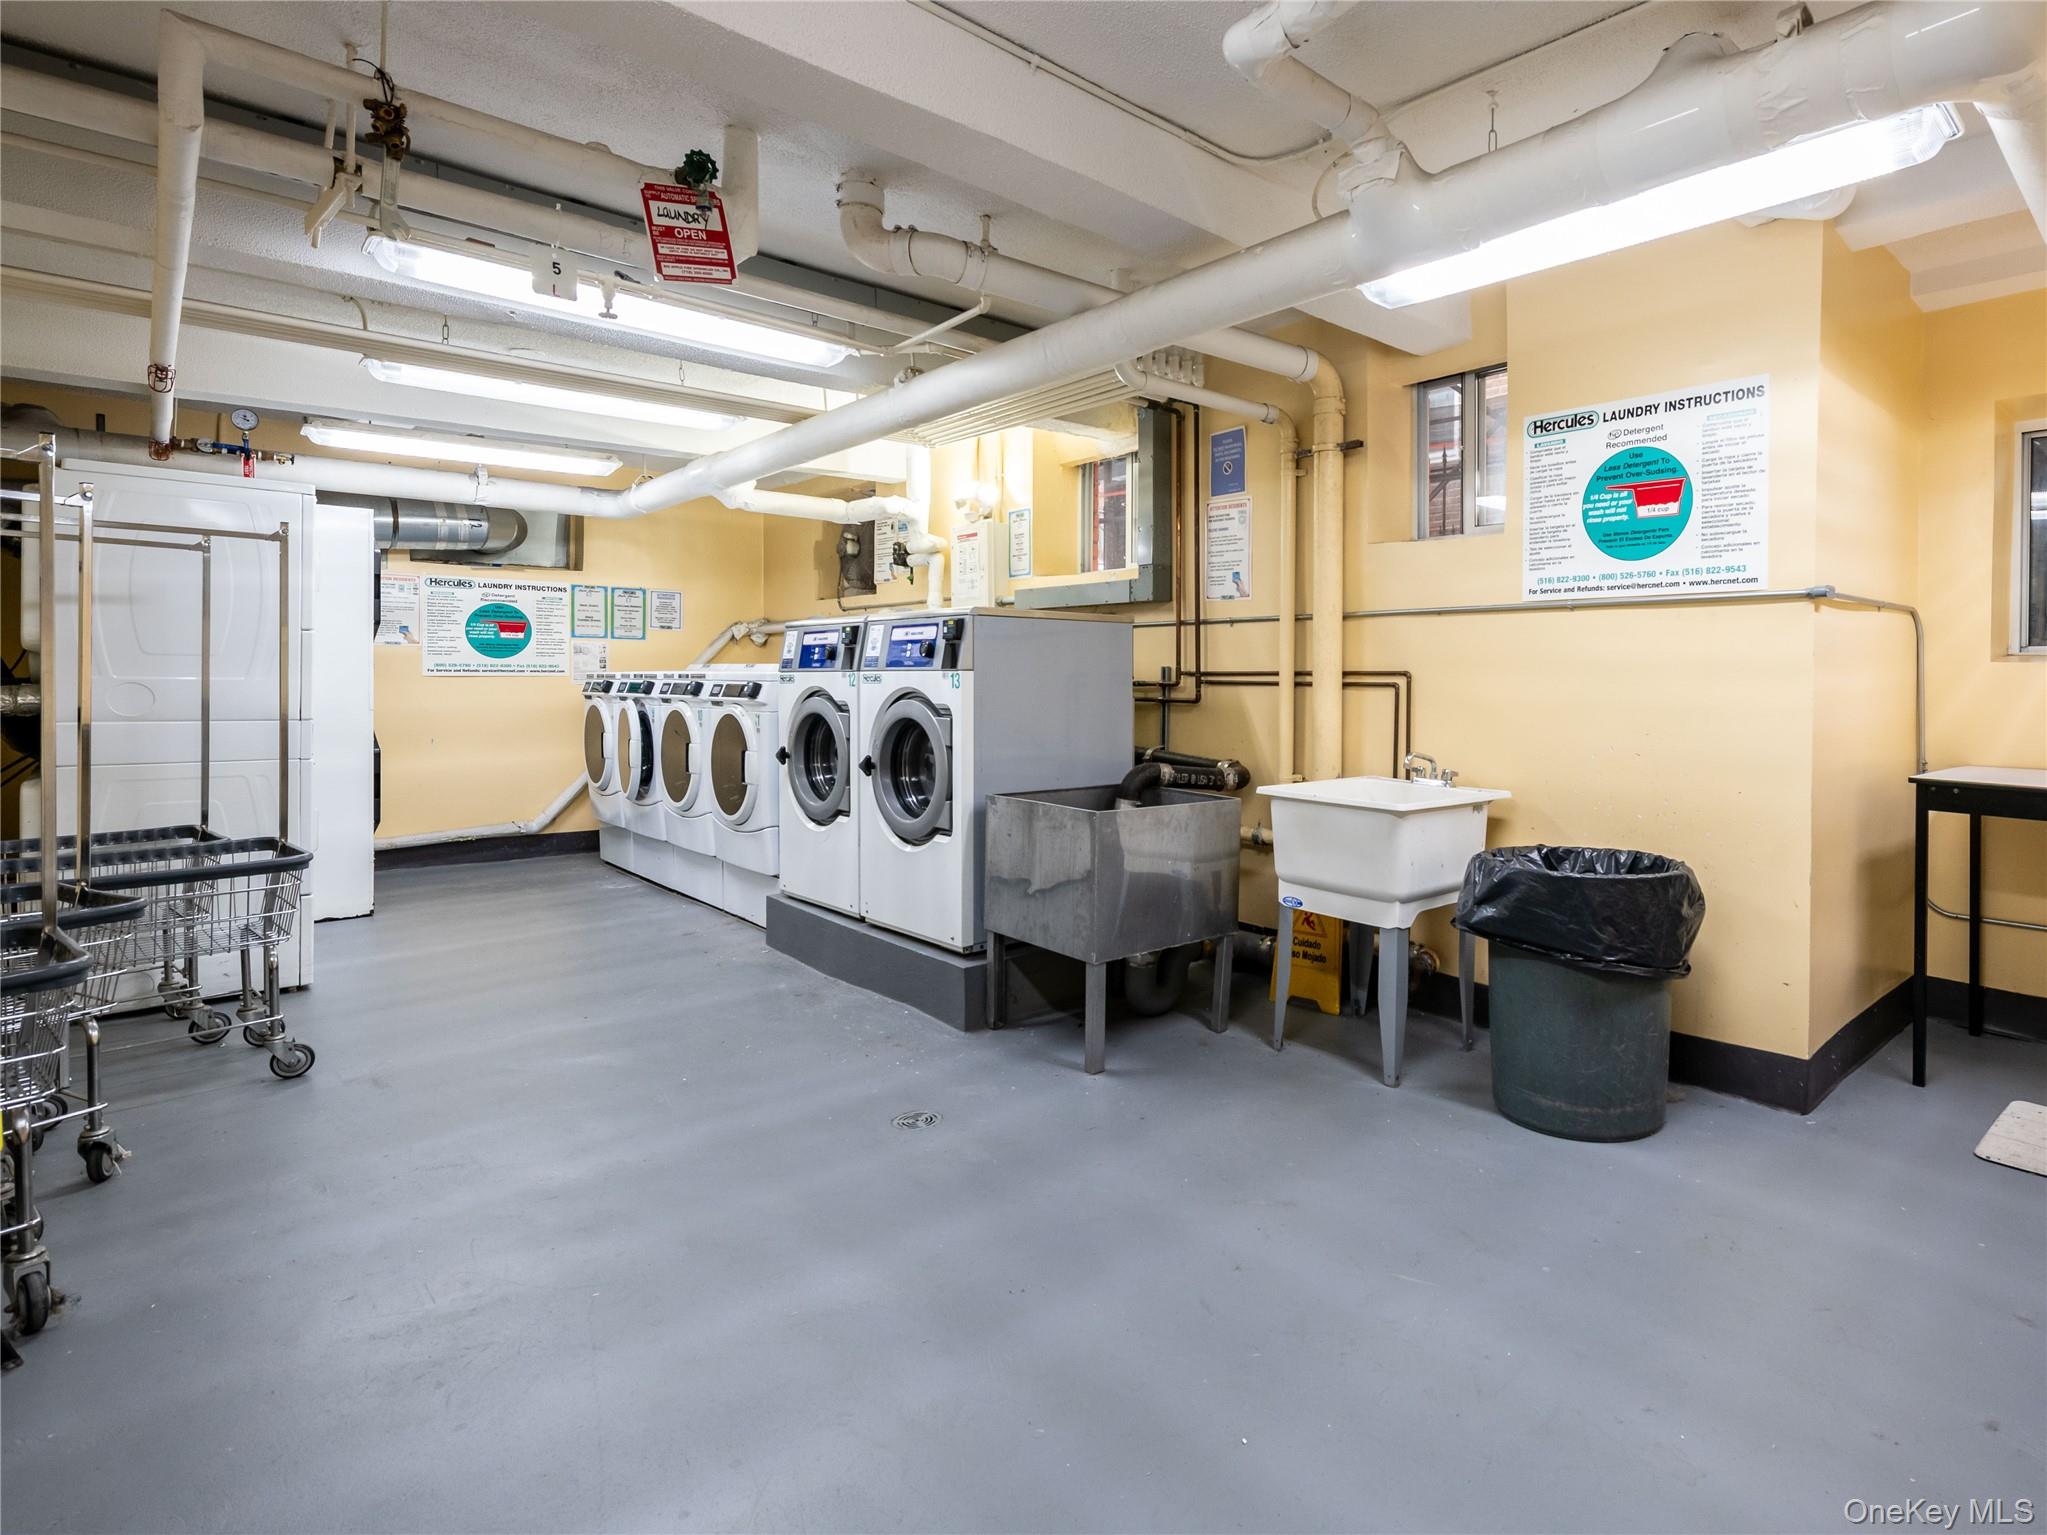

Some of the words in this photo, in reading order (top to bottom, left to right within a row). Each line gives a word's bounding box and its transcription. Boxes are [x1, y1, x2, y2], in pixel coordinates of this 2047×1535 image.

[674, 228, 707, 240] OPEN
[552, 261, 562, 276] 5
[1533, 413, 1594, 435] Hercules
[1603, 402, 1661, 423] LAUNDRY
[1664, 384, 1766, 413] INSTRUCTIONS
[1623, 424, 1664, 437] Detergent
[1606, 434, 1668, 449] Recommended
[1623, 459, 1659, 470] Detergent
[1596, 472, 1624, 482] Prevent
[1598, 572, 1618, 583] (800)
[1665, 569, 1680, 577] Fax
[1682, 567, 1704, 577] (516)
[1705, 564, 1747, 575] 822-9543
[429, 577, 473, 588] Hercules
[477, 582, 513, 590] LAUNDRY
[514, 583, 568, 593] INSTRUCTIONS
[1577, 584, 1605, 592] Refunds:
[1606, 581, 1681, 592] service@hercnet.com
[1688, 576, 1759, 587] www.hercnet.com
[848, 672, 856, 687] 12
[951, 672, 961, 689] 13
[1292, 936, 1322, 950] Cuidado
[1301, 950, 1328, 964] Mojado
